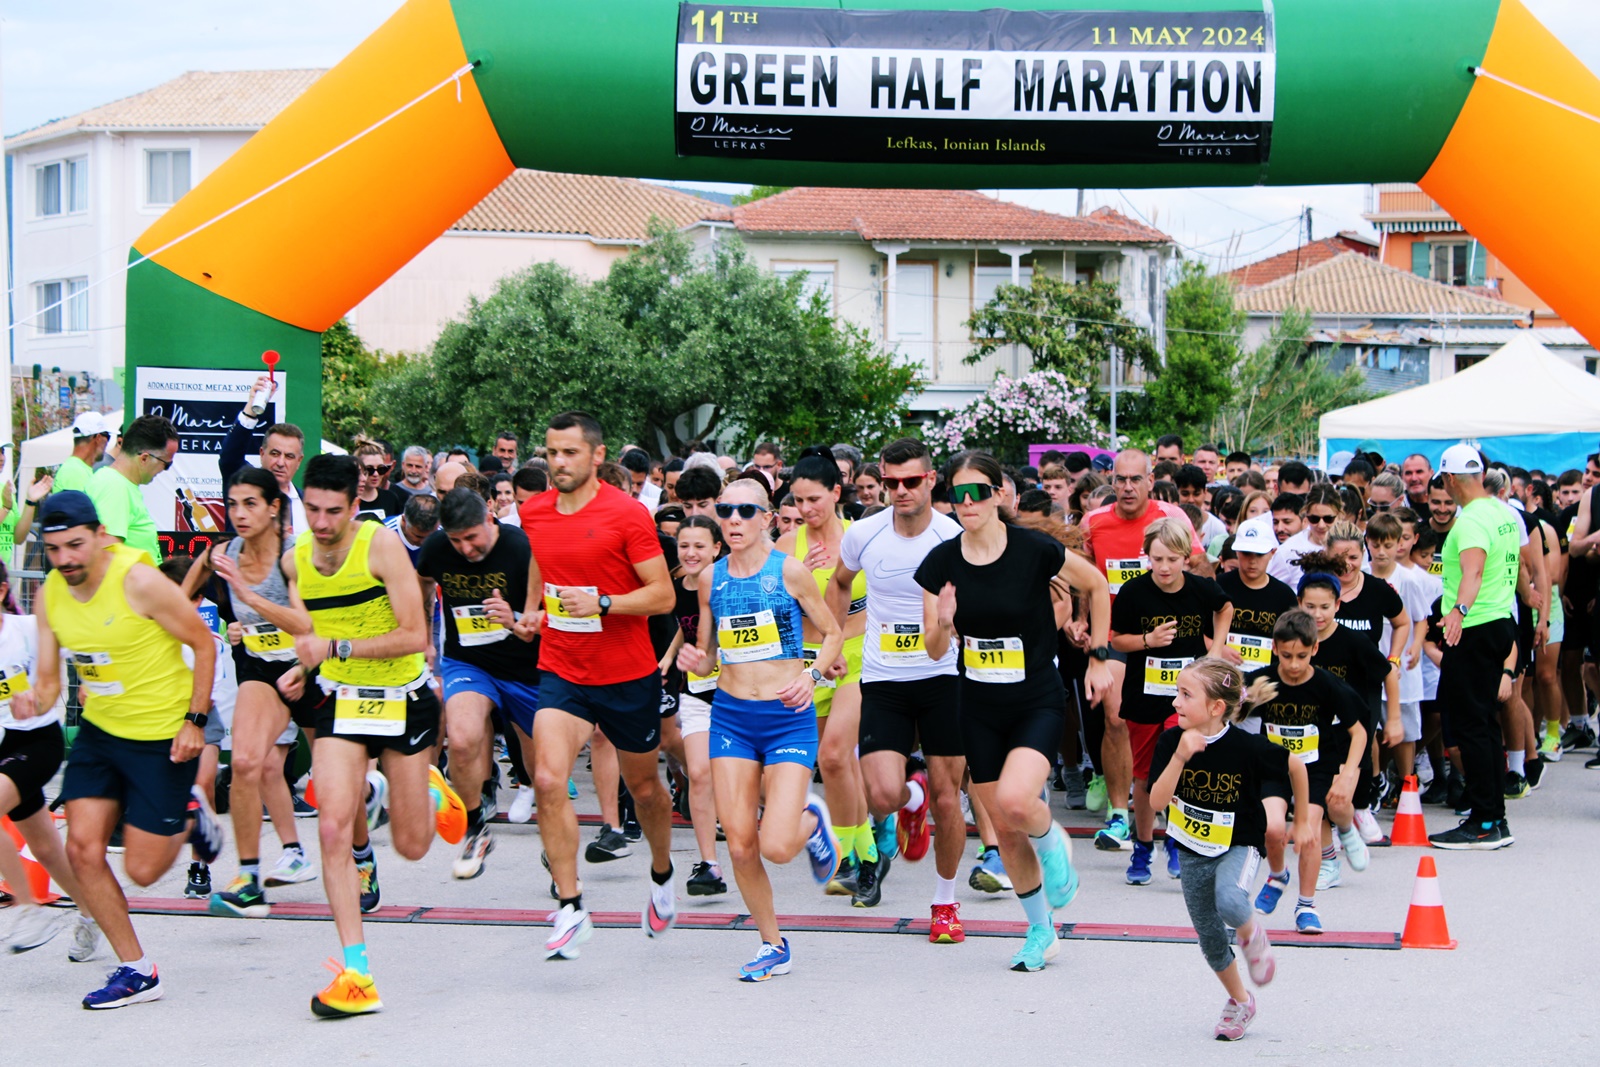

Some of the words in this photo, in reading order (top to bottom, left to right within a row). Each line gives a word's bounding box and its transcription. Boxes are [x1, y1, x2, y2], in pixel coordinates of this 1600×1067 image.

[691, 9, 724, 44] 11
[729, 11, 759, 24] TH
[1092, 27, 1118, 45] 11
[1129, 27, 1193, 46] MAY
[1201, 25, 1265, 46] 2024
[690, 51, 838, 109] GREEN
[870, 56, 983, 111] HALF
[1013, 59, 1262, 114] MARATHON
[690, 116, 706, 132] D
[712, 115, 793, 134] Marin
[1157, 124, 1173, 140] D
[1178, 123, 1260, 141] Marin
[714, 140, 766, 150] LEFKAS
[886, 136, 938, 151] Lefkas,
[944, 138, 989, 151] Ionian
[995, 138, 1046, 152] Islands
[1179, 148, 1231, 156] LEFKAS
[147, 382, 203, 391] ΑΠΟΚΛΕΙΣΤΙΚΟΣ
[205, 384, 233, 392] ΜΕΓΑΣ
[181, 439, 223, 451] EFKA
[733, 628, 759, 644] 723
[895, 634, 919, 649] 667
[980, 651, 1004, 664] 911
[1240, 646, 1260, 659] 813
[358, 701, 385, 714] 627
[1282, 738, 1303, 751] 853
[1211, 789, 1240, 804] TEAM
[1184, 817, 1211, 837] 793
